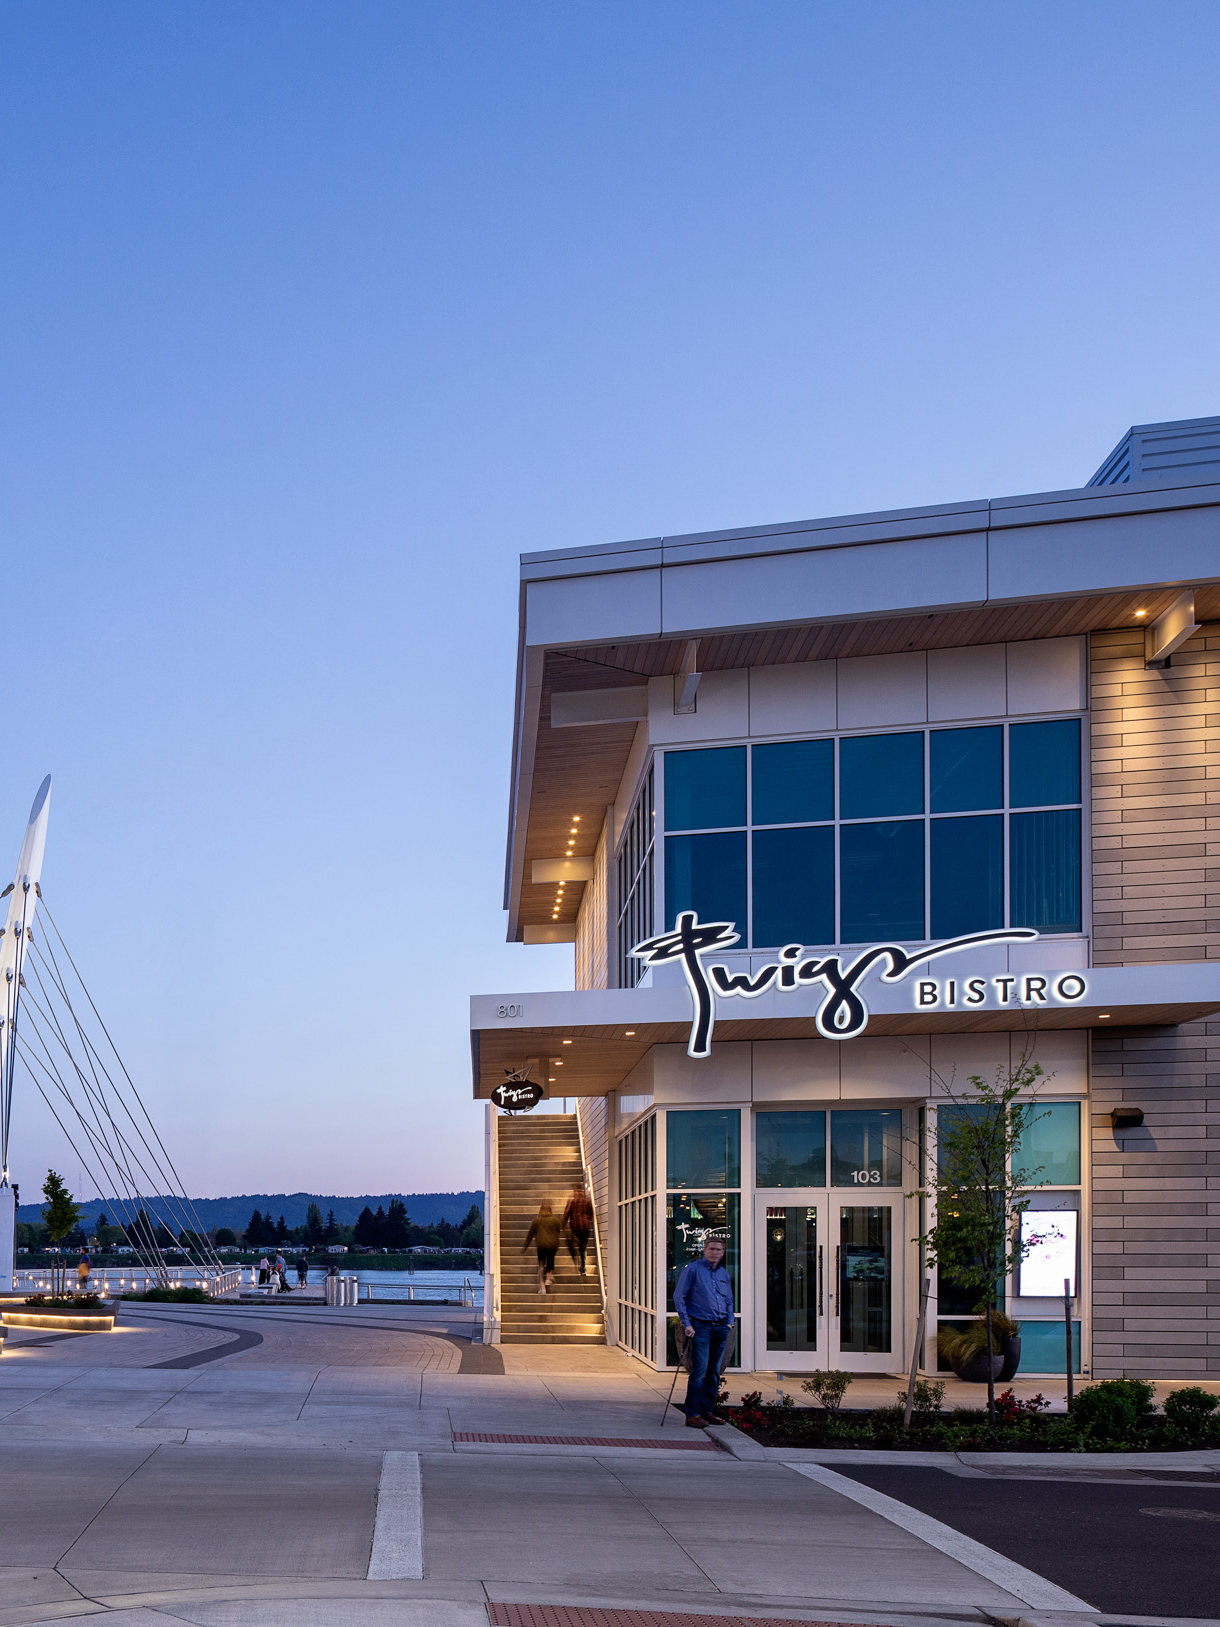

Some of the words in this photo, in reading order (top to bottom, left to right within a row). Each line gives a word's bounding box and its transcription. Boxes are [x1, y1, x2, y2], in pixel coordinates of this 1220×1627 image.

[627, 910, 1040, 1058] Twigs
[918, 974, 1087, 1007] BISTRO
[497, 1004, 524, 1018] 801
[496, 1085, 532, 1105] Twigs
[850, 1170, 881, 1184] 103
[675, 1222, 729, 1242] Twigs
